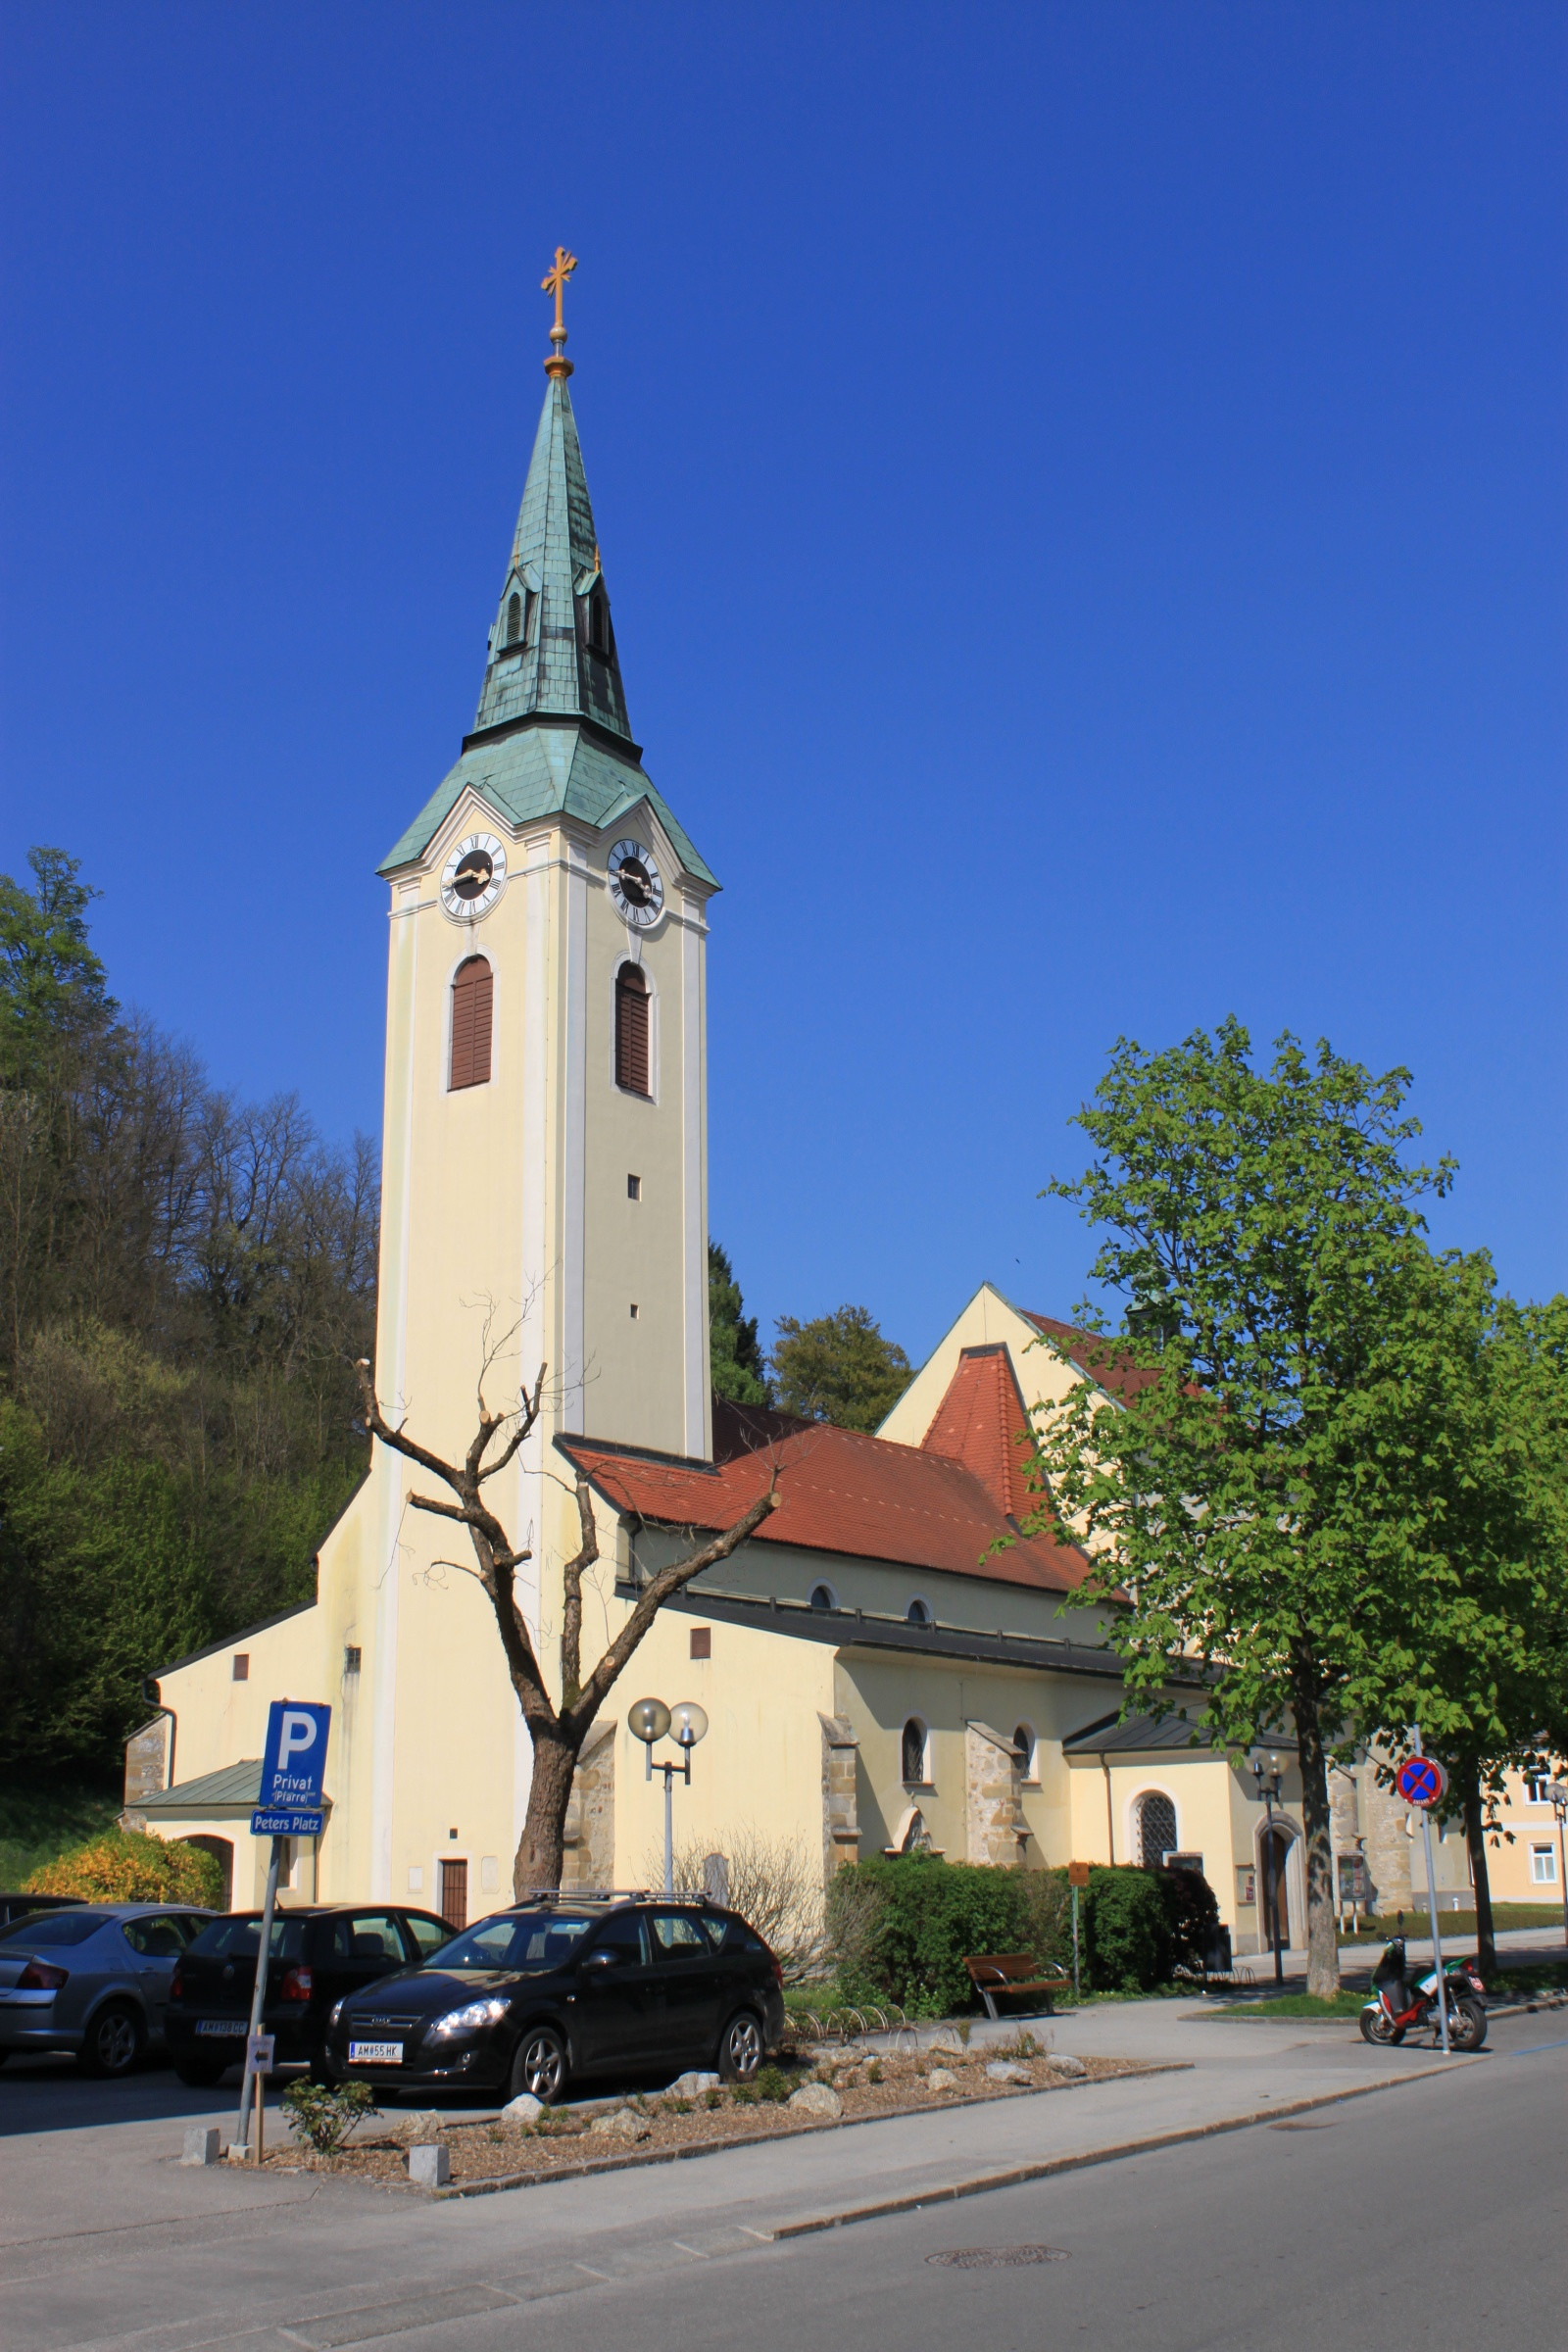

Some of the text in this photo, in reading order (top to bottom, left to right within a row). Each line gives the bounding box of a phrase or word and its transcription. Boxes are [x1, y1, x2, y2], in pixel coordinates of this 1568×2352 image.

[277, 1711, 318, 1770] P
[272, 1774, 313, 1789] Privat
[255, 1816, 319, 1831] Peters Platz
[358, 2045, 398, 2056] AM 55 HK
